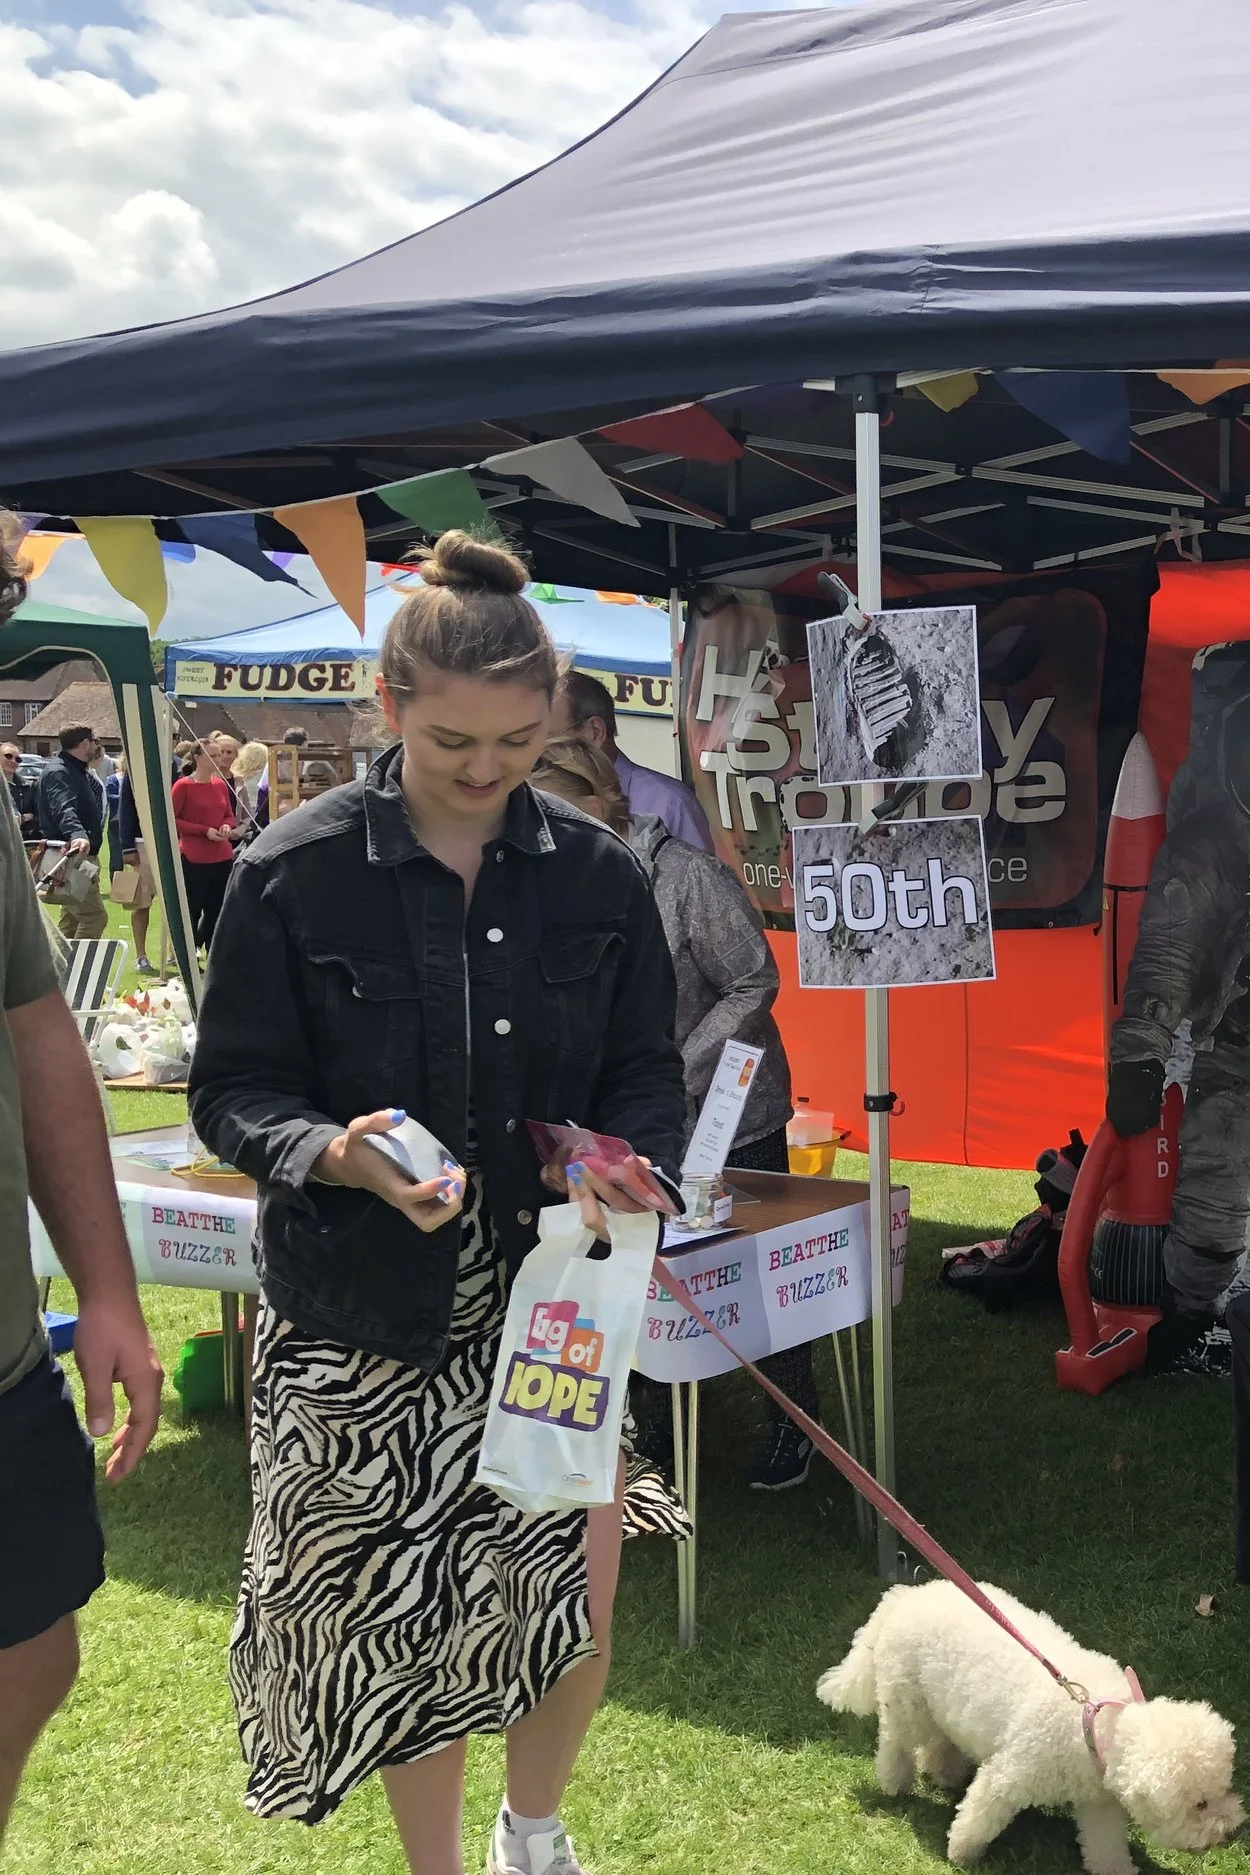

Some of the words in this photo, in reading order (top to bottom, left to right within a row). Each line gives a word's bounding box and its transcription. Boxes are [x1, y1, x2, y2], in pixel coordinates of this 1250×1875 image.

[211, 663, 356, 692] FUDGE
[614, 674, 673, 707] FU
[803, 858, 979, 933] 50th
[158, 1238, 237, 1267] BUZZER
[776, 1265, 849, 1308] BUZZER
[568, 1337, 598, 1368] of
